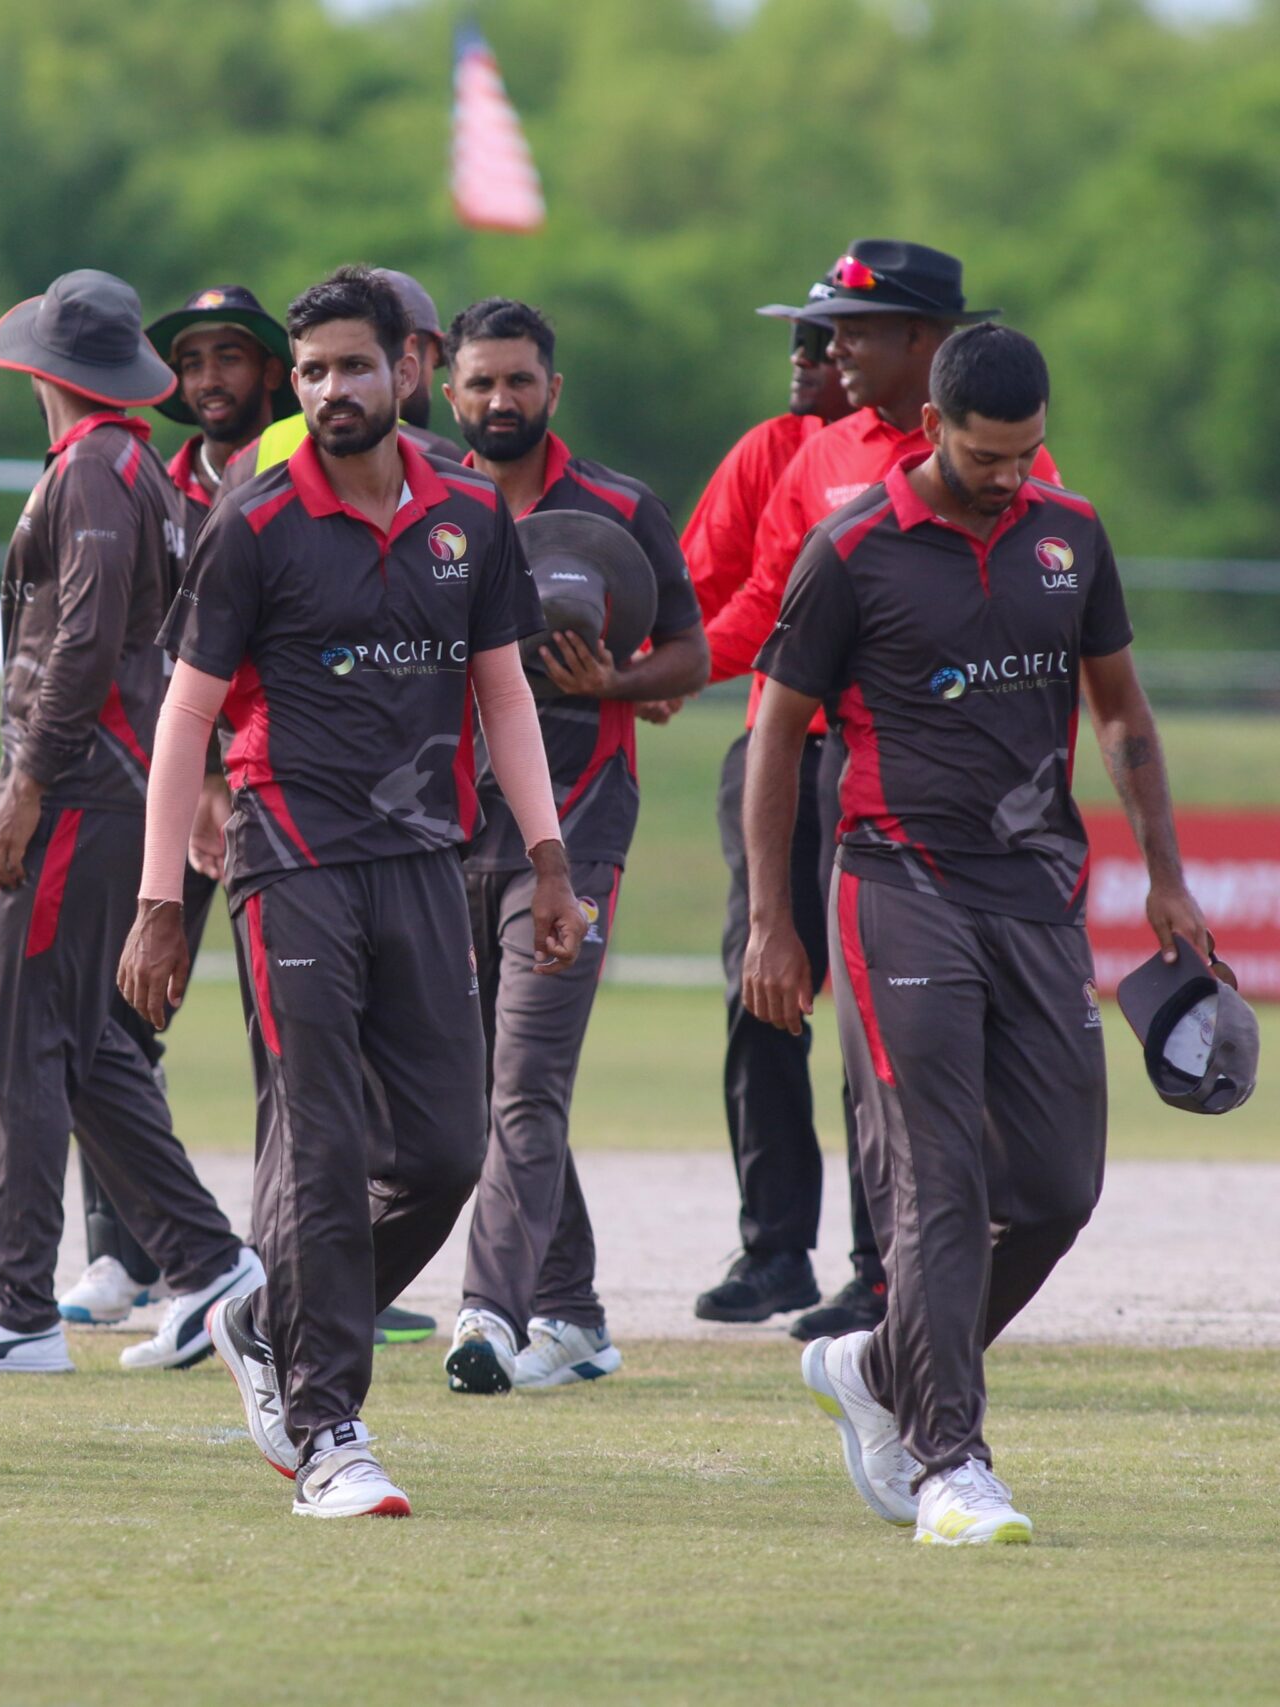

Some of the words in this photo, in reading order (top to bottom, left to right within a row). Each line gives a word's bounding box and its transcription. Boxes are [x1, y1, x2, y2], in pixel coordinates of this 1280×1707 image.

[432, 563, 469, 580] UAE
[1042, 573, 1078, 589] UAE
[355, 640, 466, 664] PACIFIC
[388, 664, 439, 677] VENTURES
[966, 651, 1068, 683] PACIFIC
